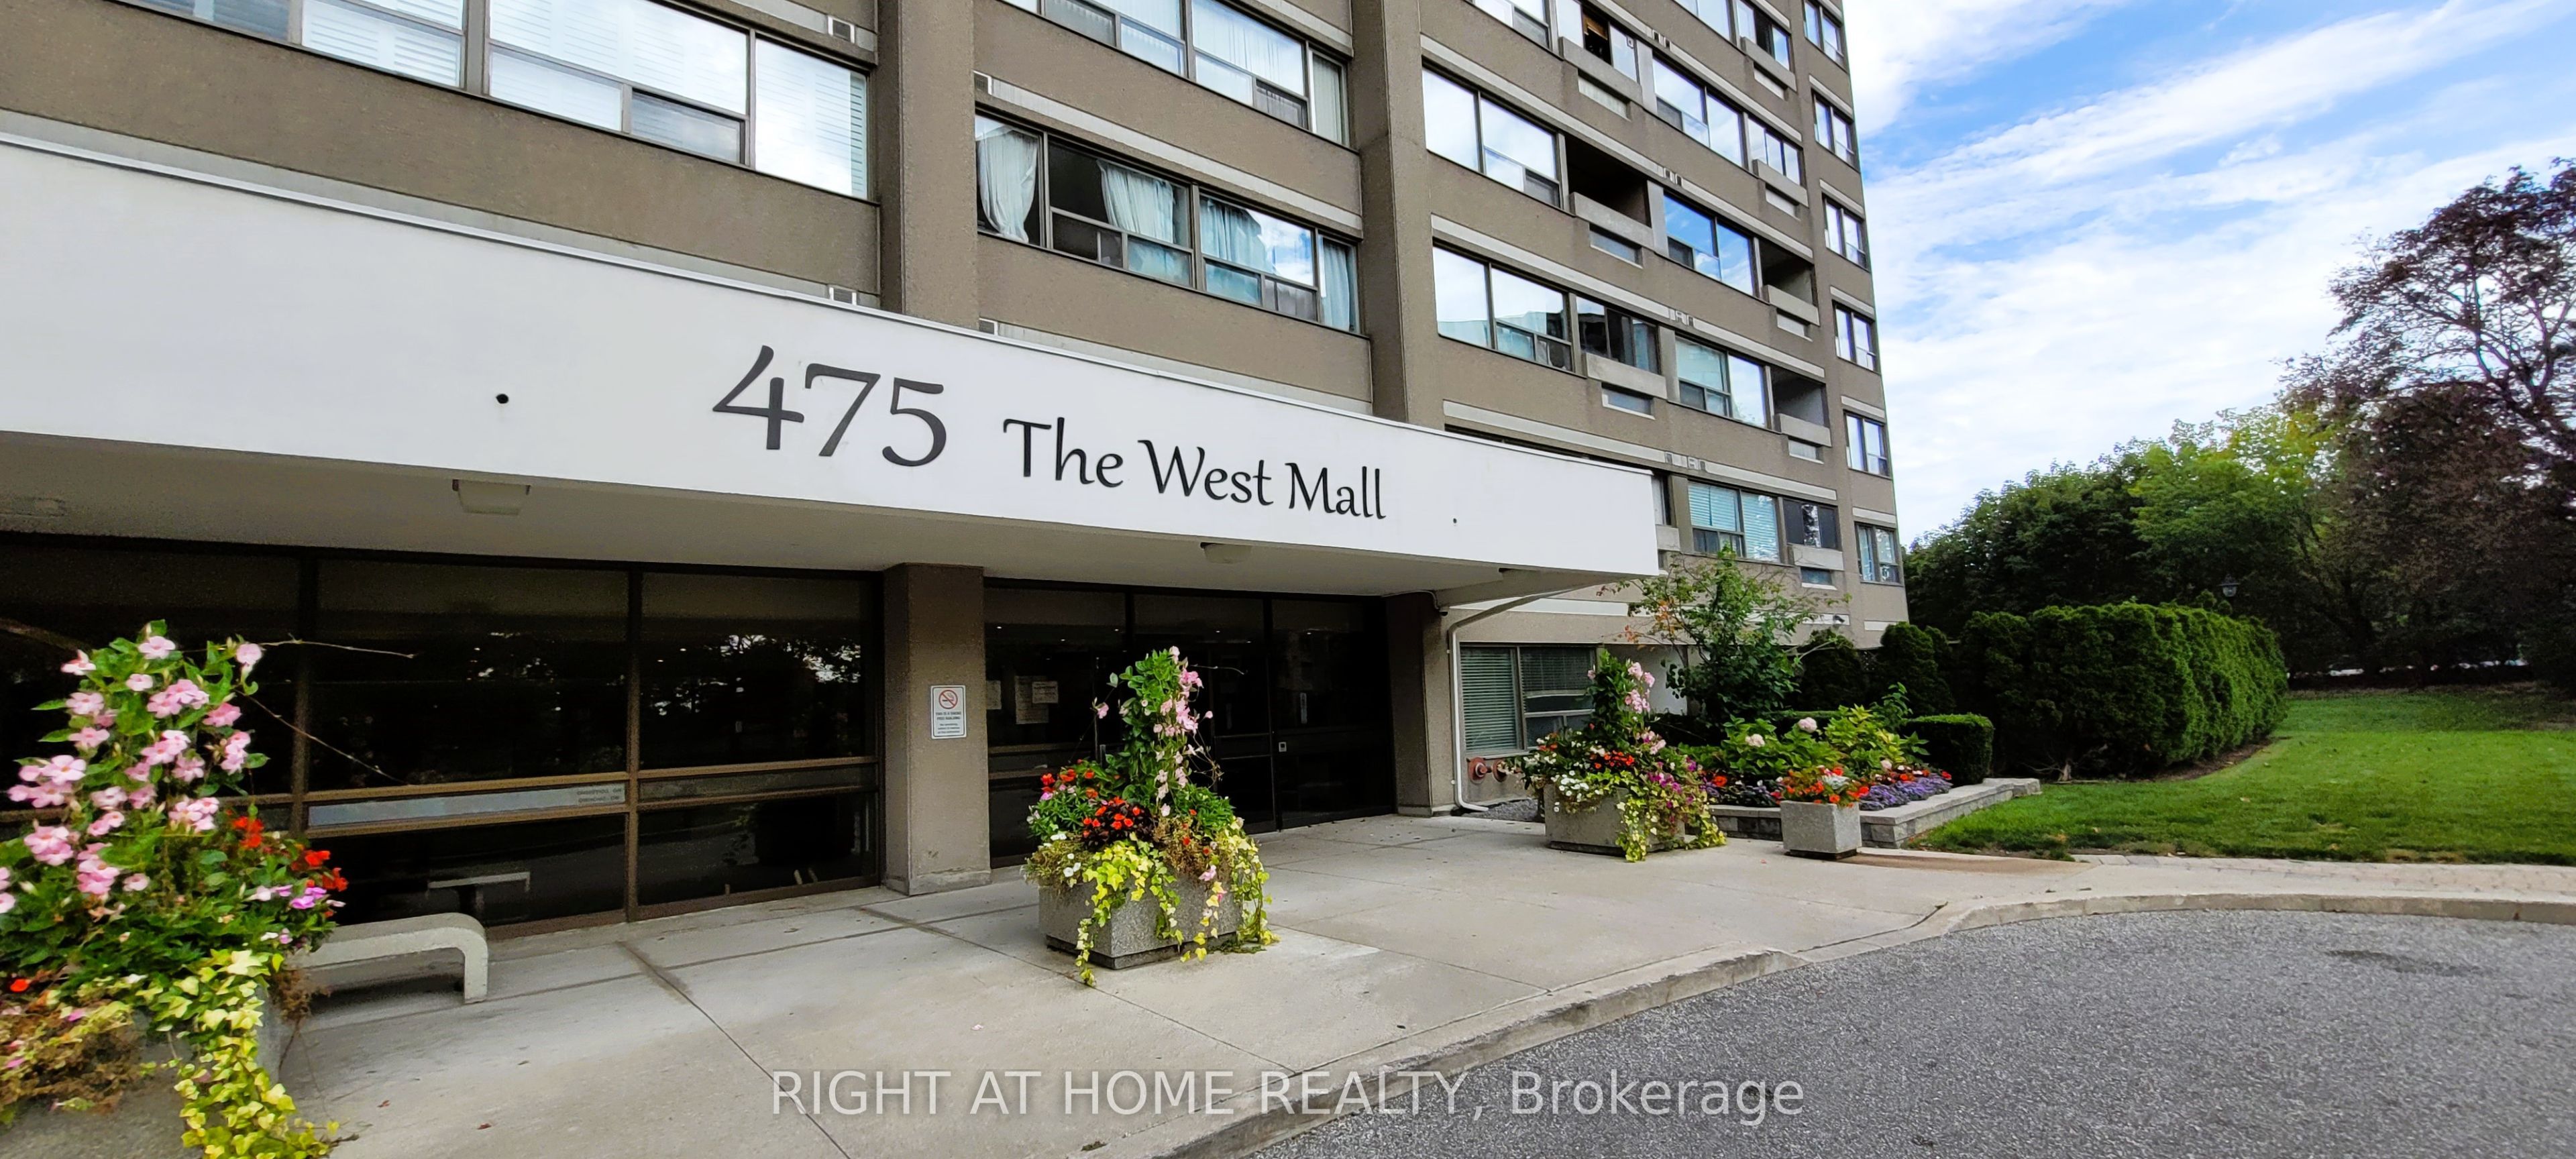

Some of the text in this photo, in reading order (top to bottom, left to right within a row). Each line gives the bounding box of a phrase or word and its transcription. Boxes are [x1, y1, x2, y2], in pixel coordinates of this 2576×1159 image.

[712, 345, 1386, 520] 475 The West Mall
